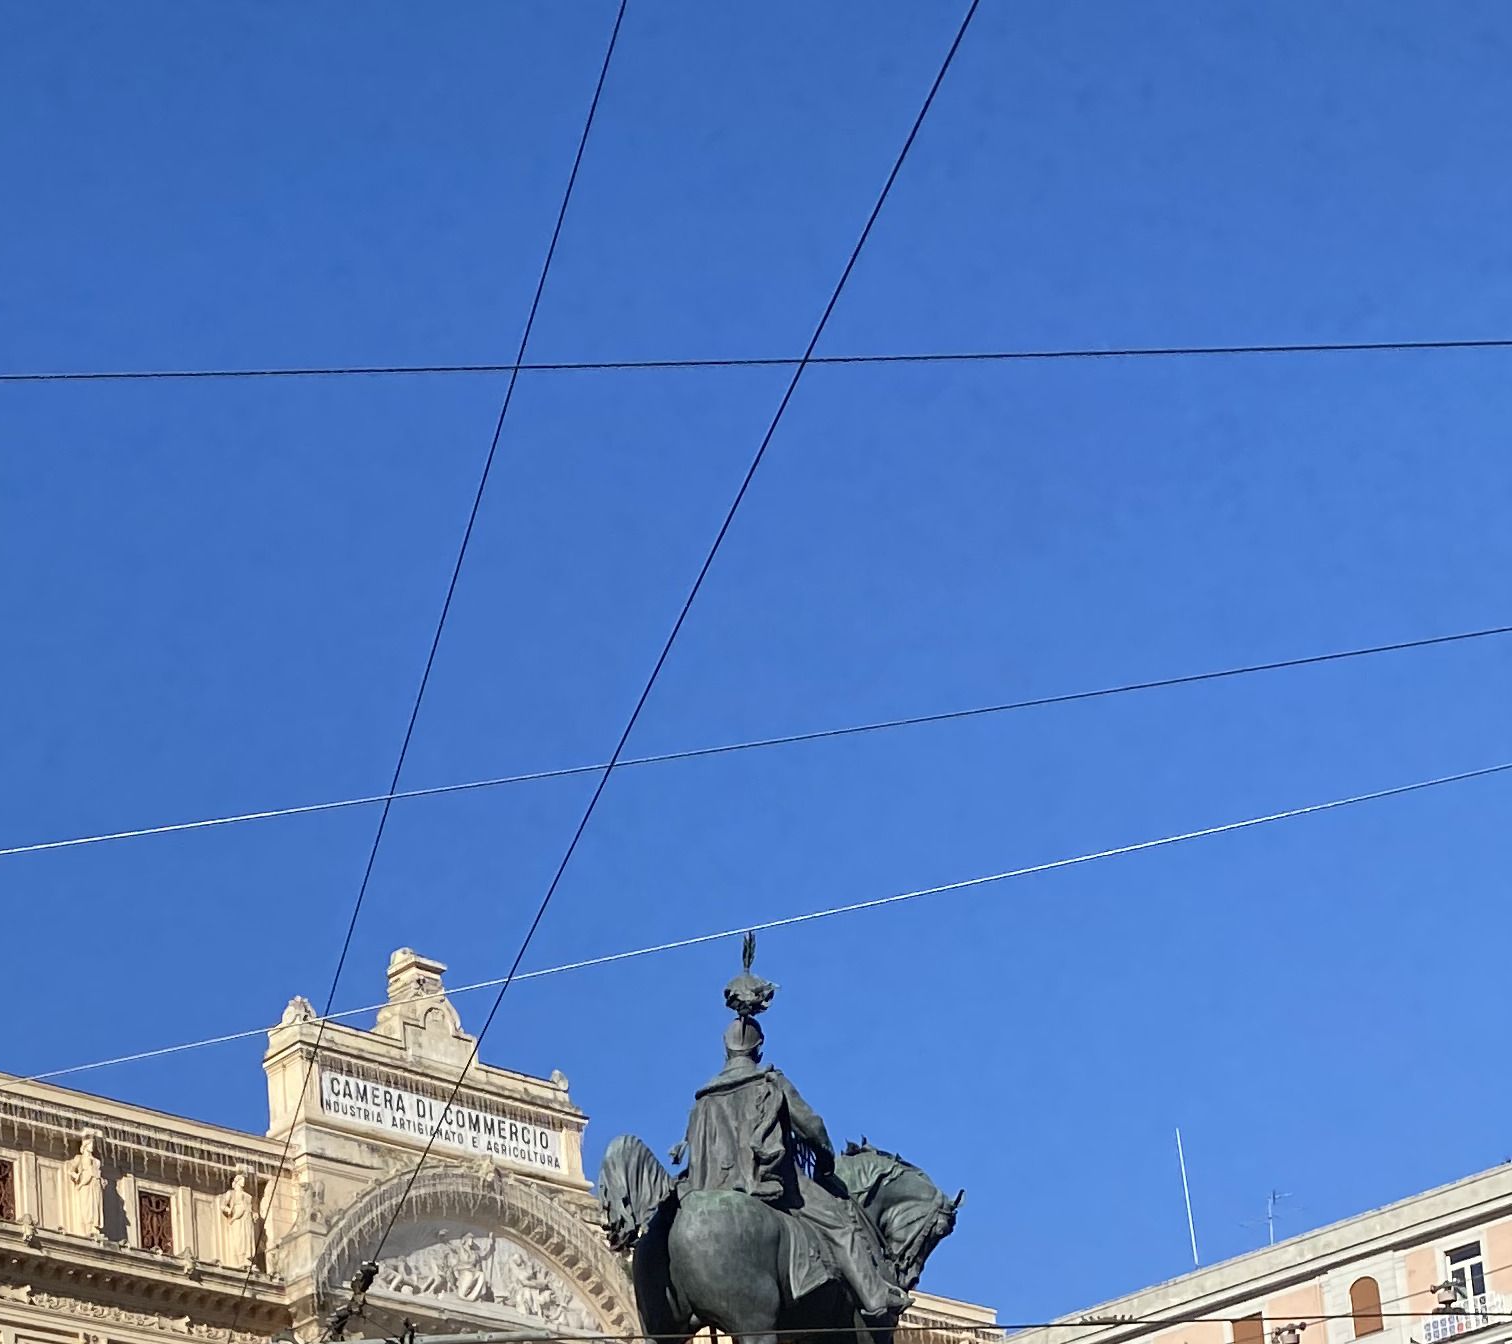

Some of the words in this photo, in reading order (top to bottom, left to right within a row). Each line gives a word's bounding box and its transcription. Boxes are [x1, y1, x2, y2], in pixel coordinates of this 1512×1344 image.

[329, 1077, 406, 1115] CAMERA
[416, 1098, 433, 1121] DI
[444, 1107, 549, 1150] COMMERCIO
[391, 1115, 464, 1145] ARTIGIANATO
[471, 1136, 479, 1149] E
[486, 1140, 561, 1169] AGRICOLTURA
